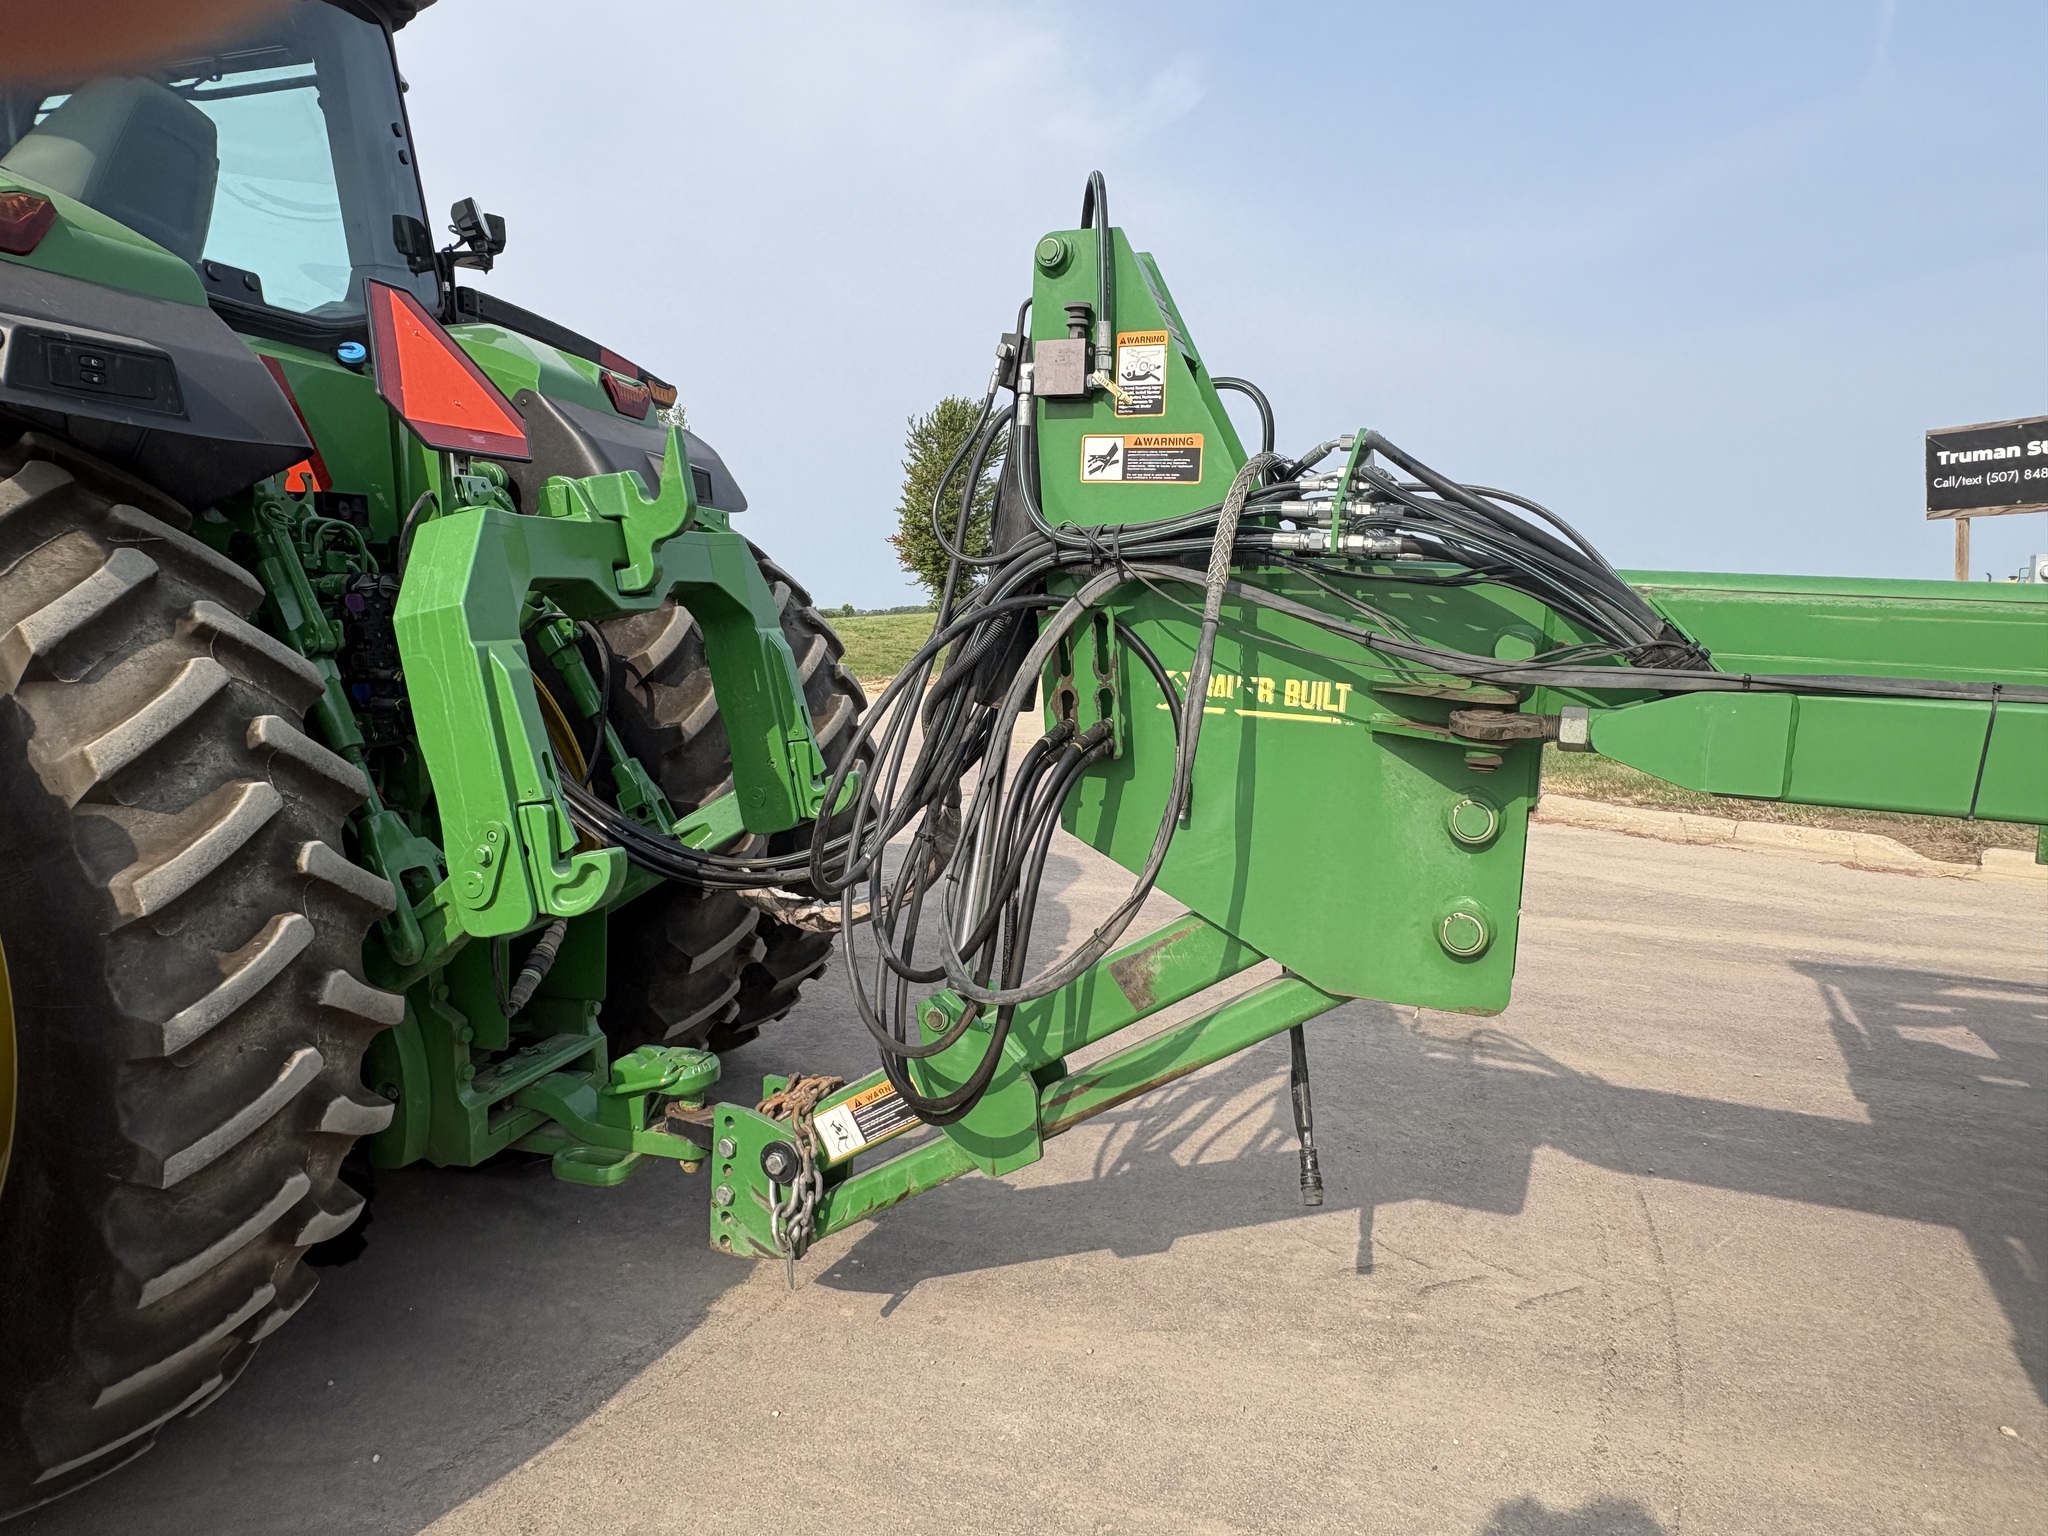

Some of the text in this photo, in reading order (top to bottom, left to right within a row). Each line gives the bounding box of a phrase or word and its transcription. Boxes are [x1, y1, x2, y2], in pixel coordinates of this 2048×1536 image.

[1127, 334, 1166, 345] WARNING
[1143, 437, 1194, 447] WARNING
[1937, 444, 2021, 466] Truman
[1933, 475, 1983, 489] Call/text
[1986, 469, 2019, 486] (507)
[1283, 679, 1353, 714] BUILT
